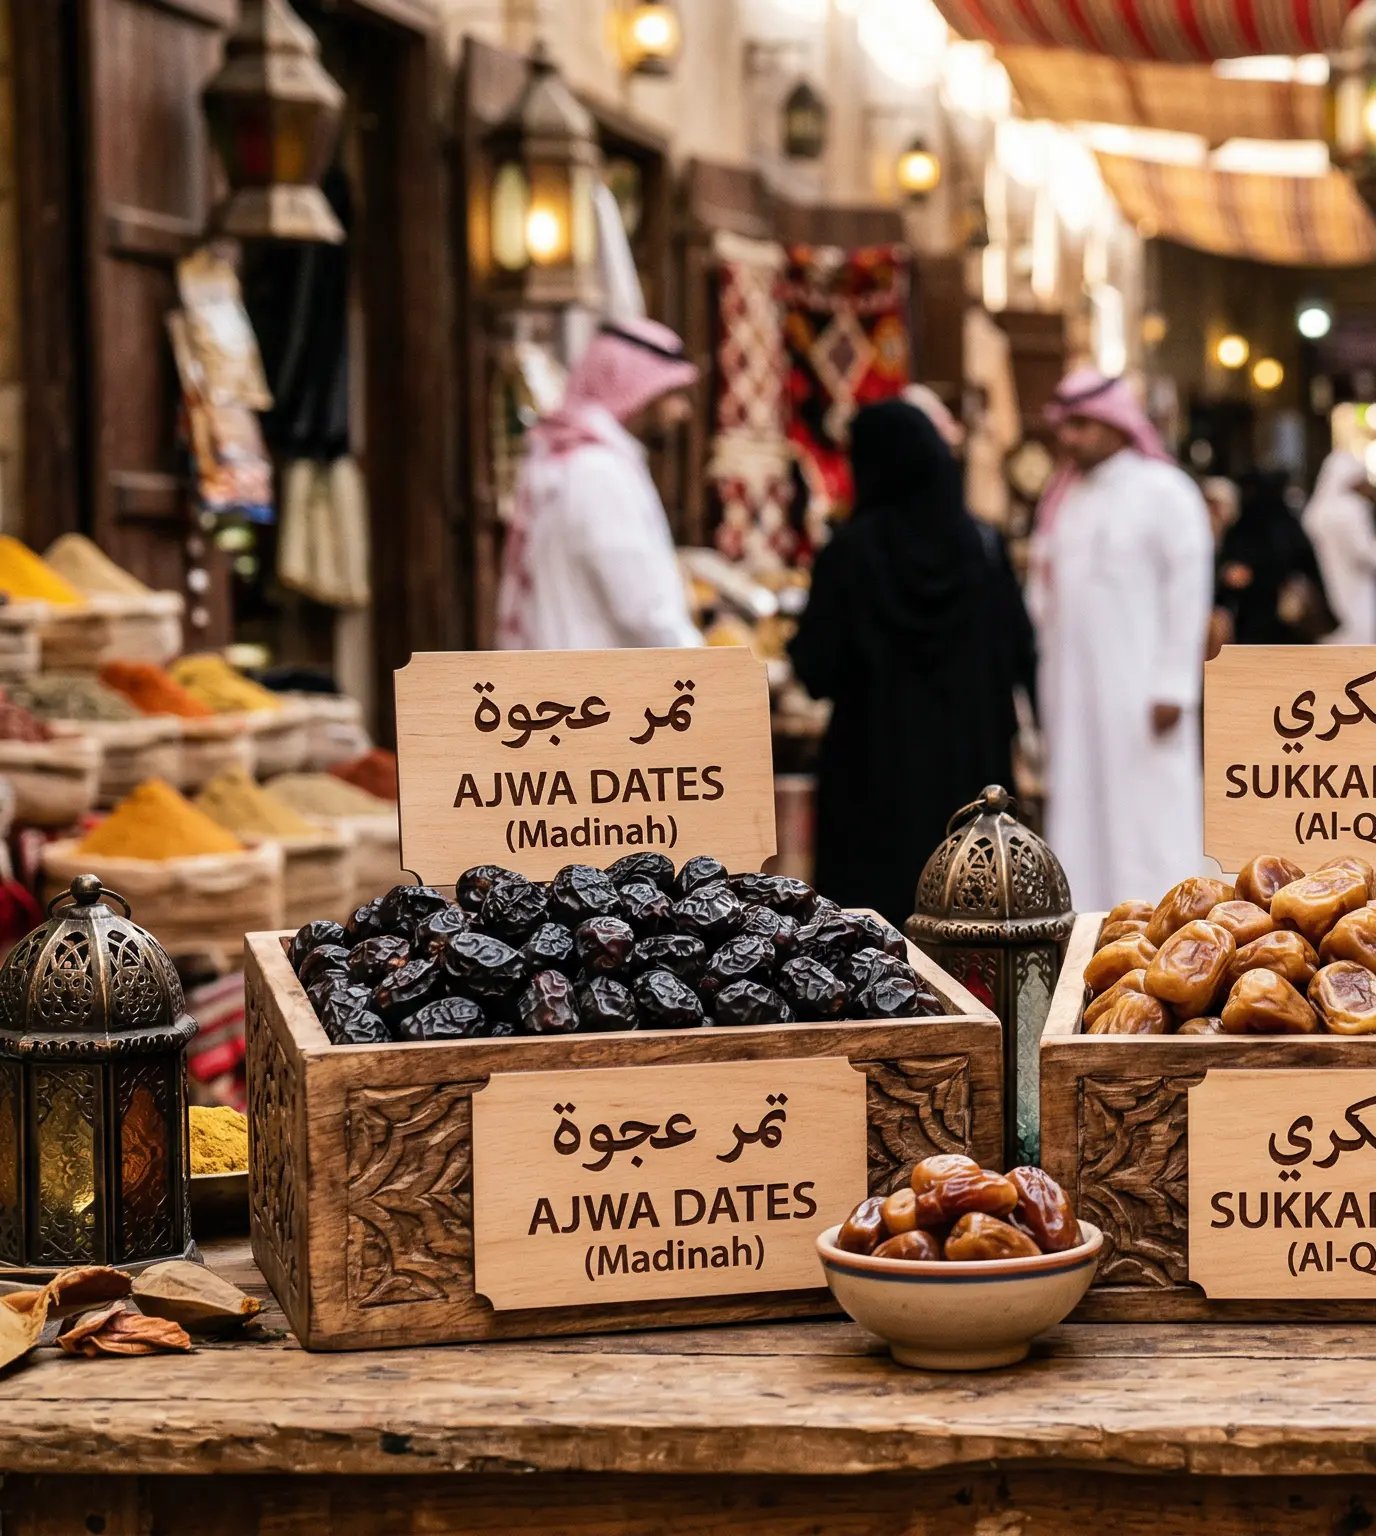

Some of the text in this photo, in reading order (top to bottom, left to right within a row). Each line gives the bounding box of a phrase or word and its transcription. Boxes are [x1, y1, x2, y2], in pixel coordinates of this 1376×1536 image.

[472, 679, 696, 749] تمر عجوة
[452, 765, 725, 808] AJWA DATES
[505, 814, 678, 854] (Madinah)
[552, 1092, 789, 1172] تمر عجوة
[527, 1181, 818, 1236] AJWA DATES
[584, 1234, 765, 1282] (Madinah)
